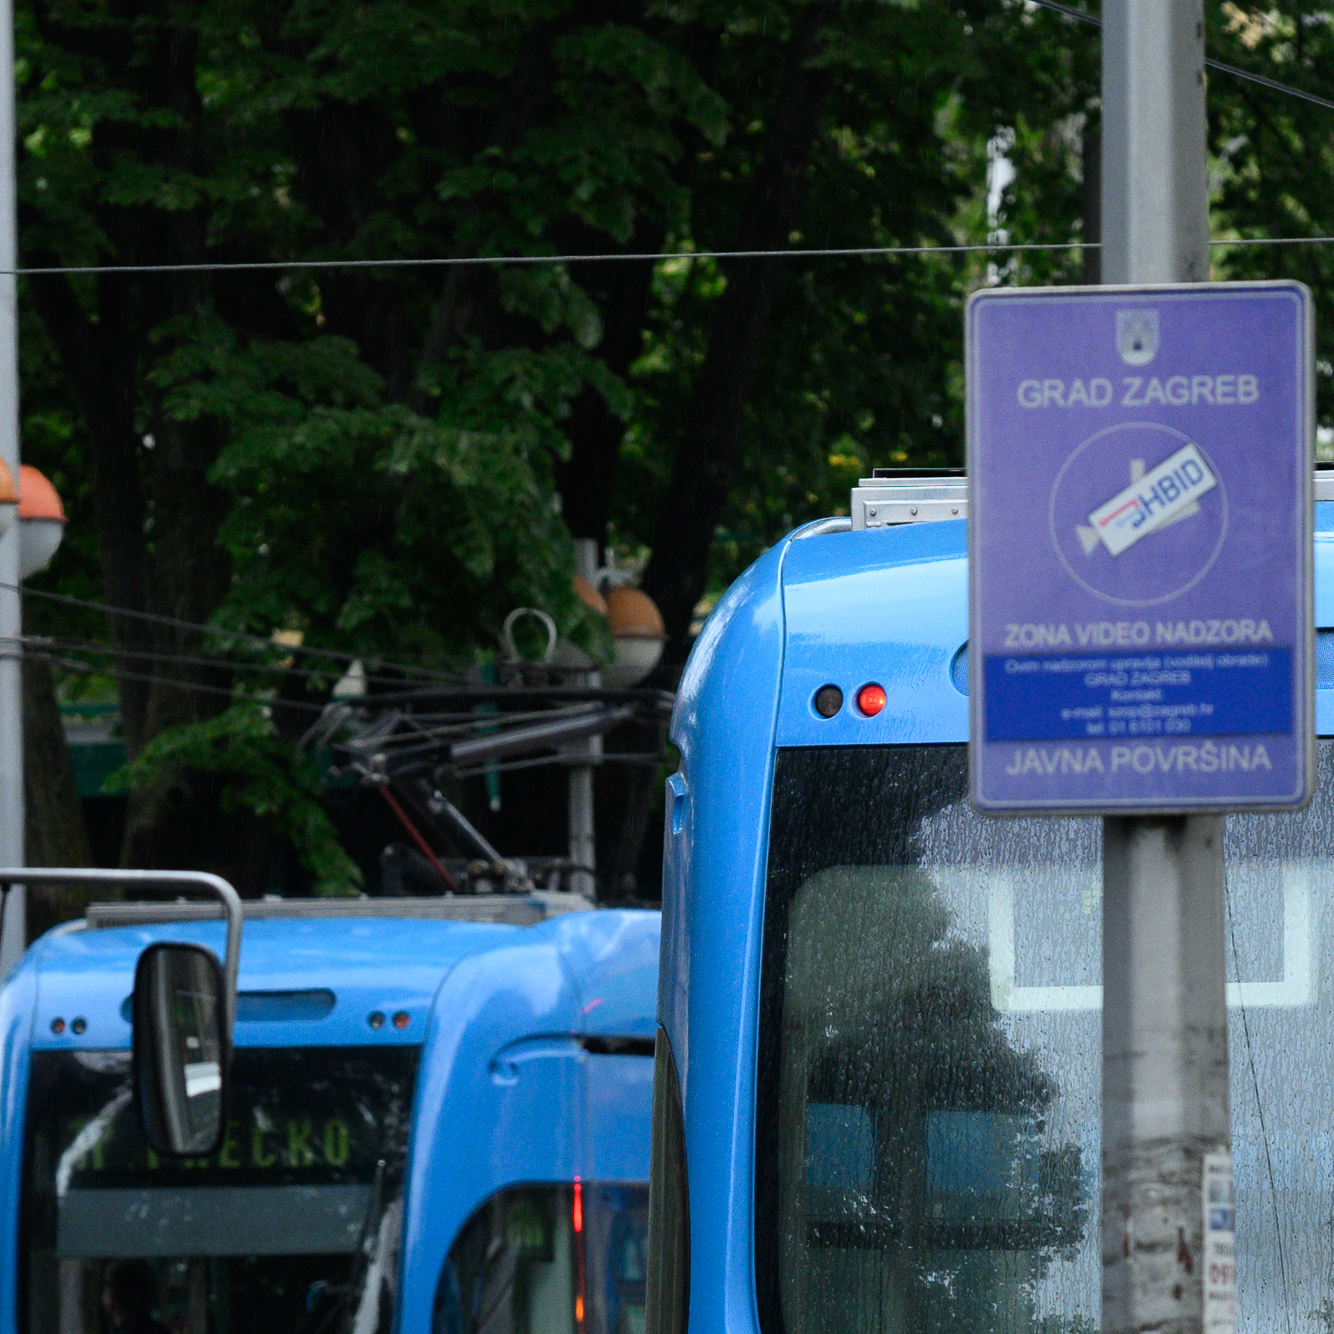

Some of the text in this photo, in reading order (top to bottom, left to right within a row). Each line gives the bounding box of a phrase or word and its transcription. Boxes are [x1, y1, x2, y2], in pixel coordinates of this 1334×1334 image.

[1017, 374, 1259, 409] GRAD ZAGREB
[1004, 618, 1273, 647] ZONA VIDEO NADZORA
[1004, 740, 1273, 776] JAVNA POVRŠINA
